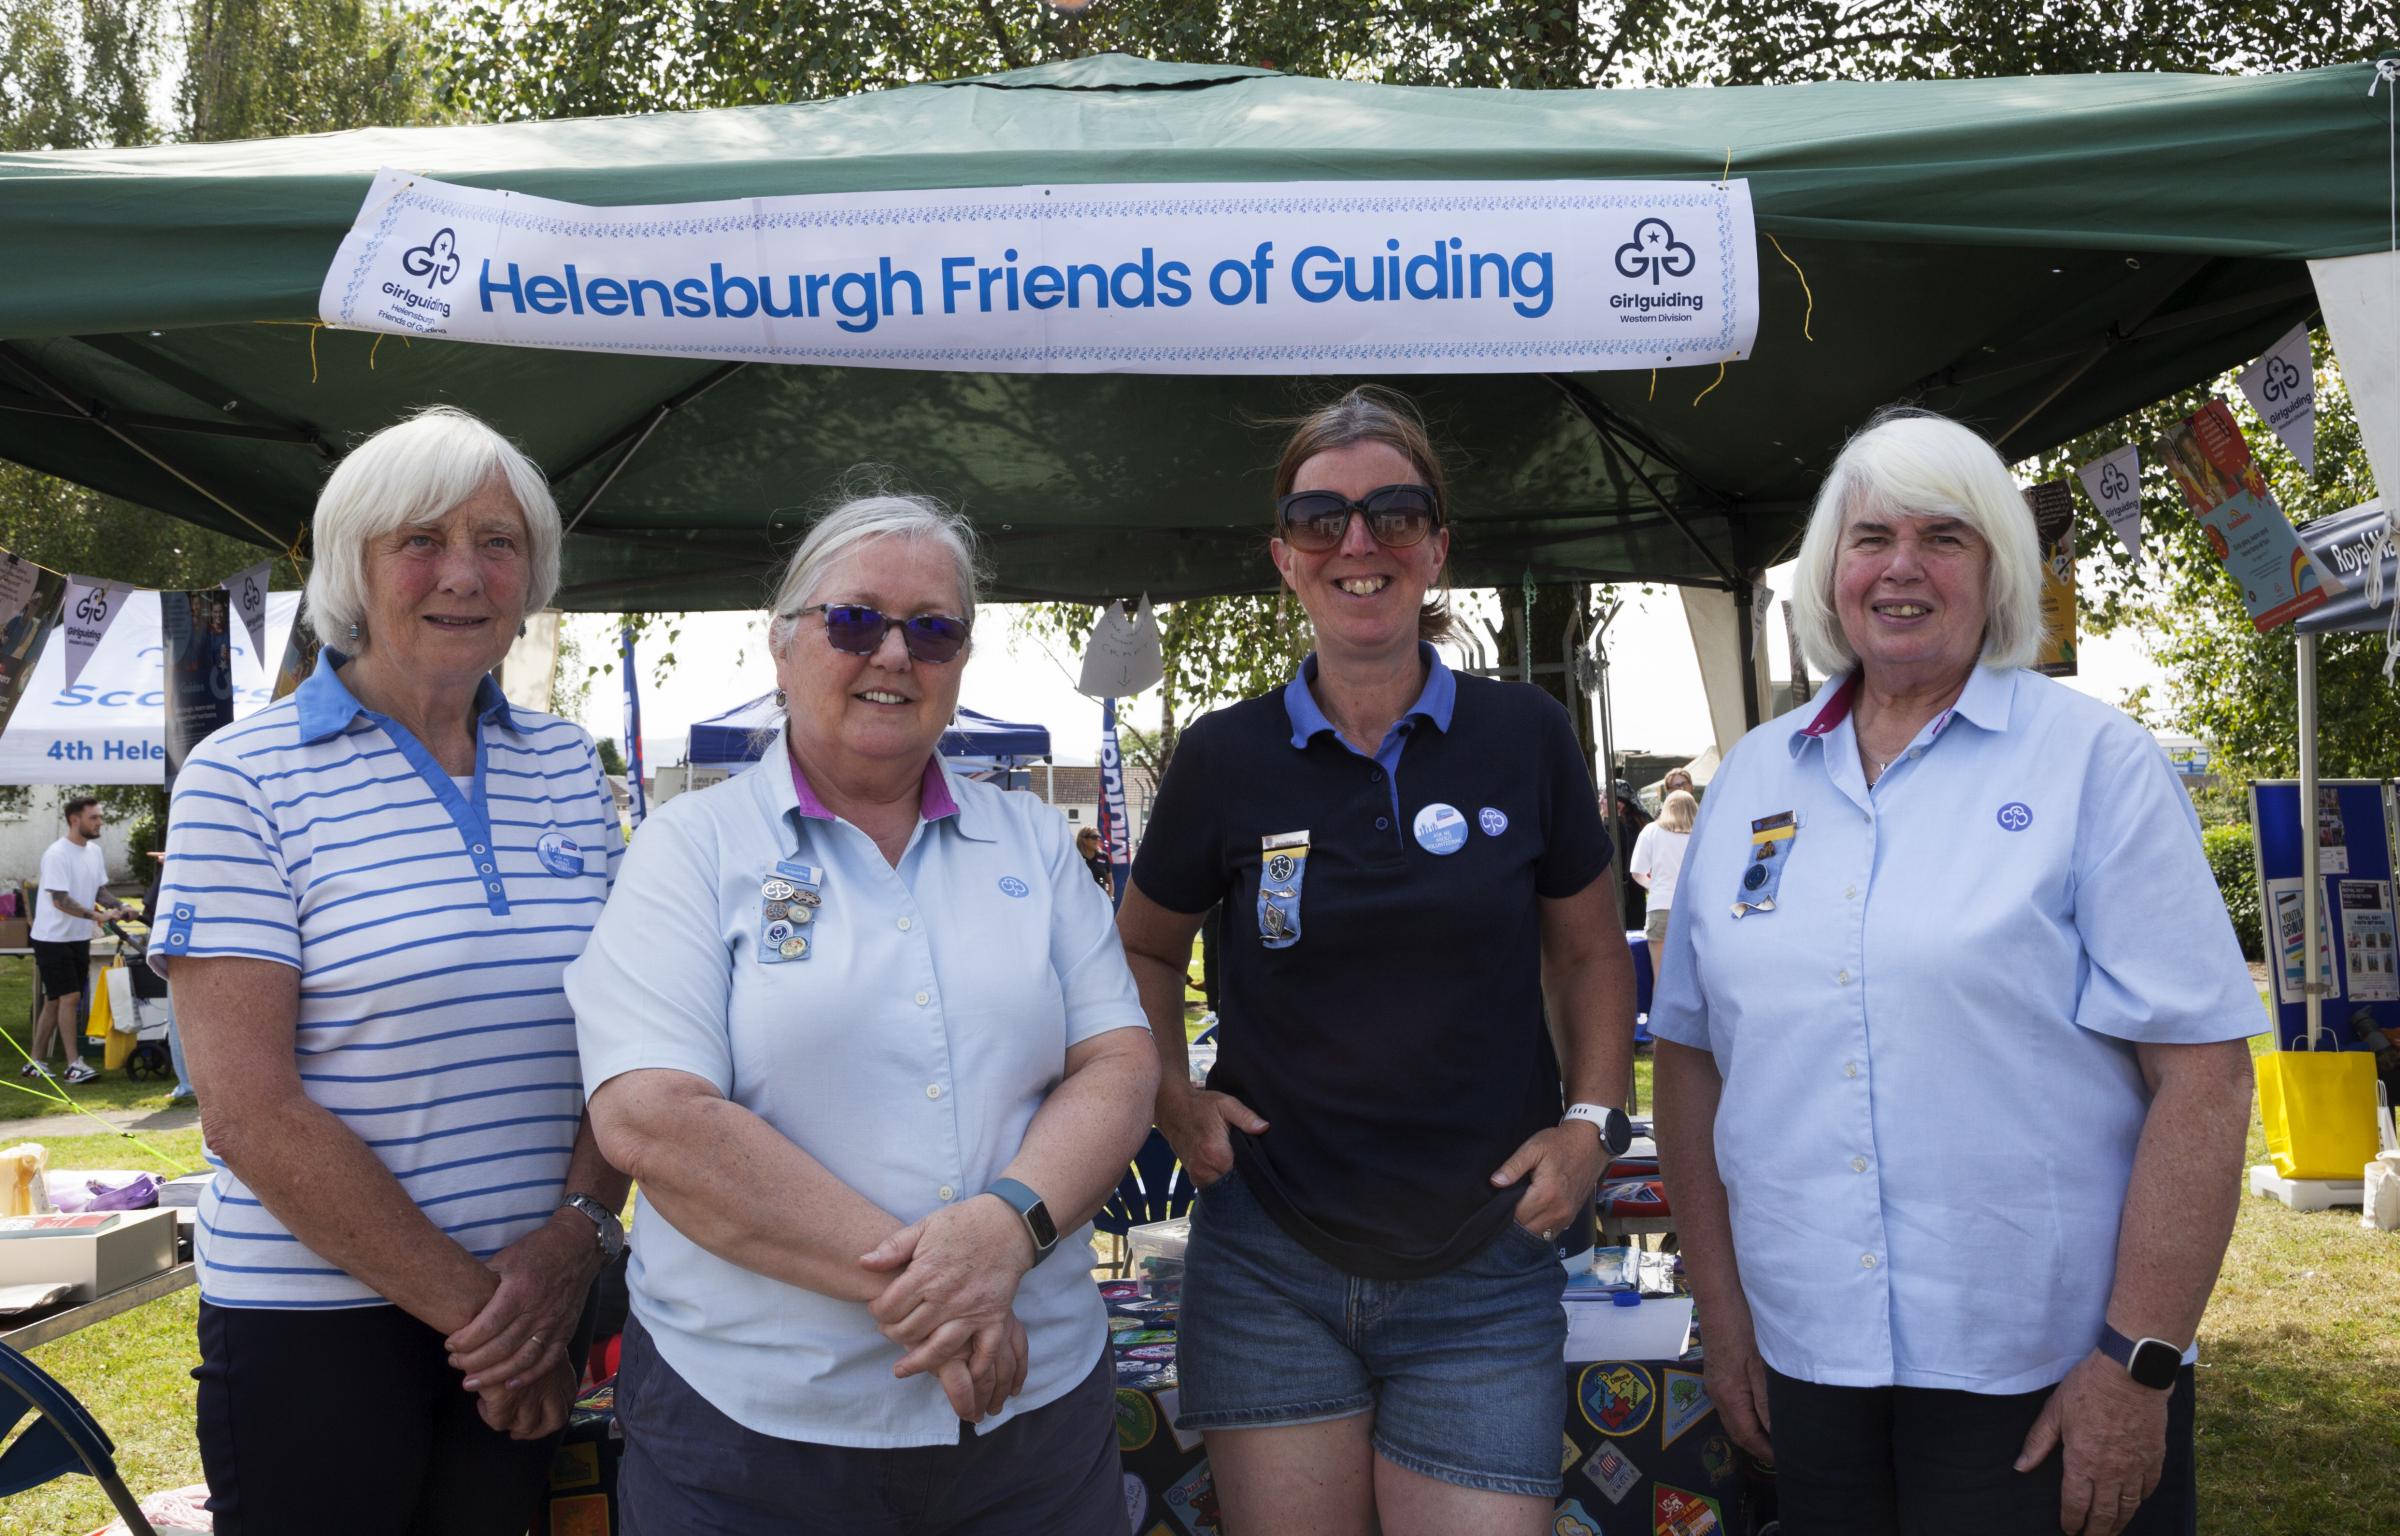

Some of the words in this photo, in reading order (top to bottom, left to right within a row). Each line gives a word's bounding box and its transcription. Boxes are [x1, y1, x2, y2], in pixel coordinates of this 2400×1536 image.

[479, 255, 924, 334] Helensburgh
[941, 246, 1192, 315] Friends
[1208, 241, 1275, 306] of
[1290, 236, 1554, 318] Guiding
[382, 281, 451, 318] Girlguiding
[1609, 292, 1703, 312] Girlguiding
[378, 309, 406, 326] Friends
[406, 320, 416, 329] of
[1620, 314, 1657, 323] Western
[1658, 313, 1692, 322] Division
[2269, 392, 2313, 425] Girlguiding
[2330, 532, 2373, 577] Royal
[51, 684, 279, 708] Scots
[47, 740, 94, 761] 4th
[1102, 730, 1129, 865] Mutual
[2282, 908, 2301, 920] YOUTH
